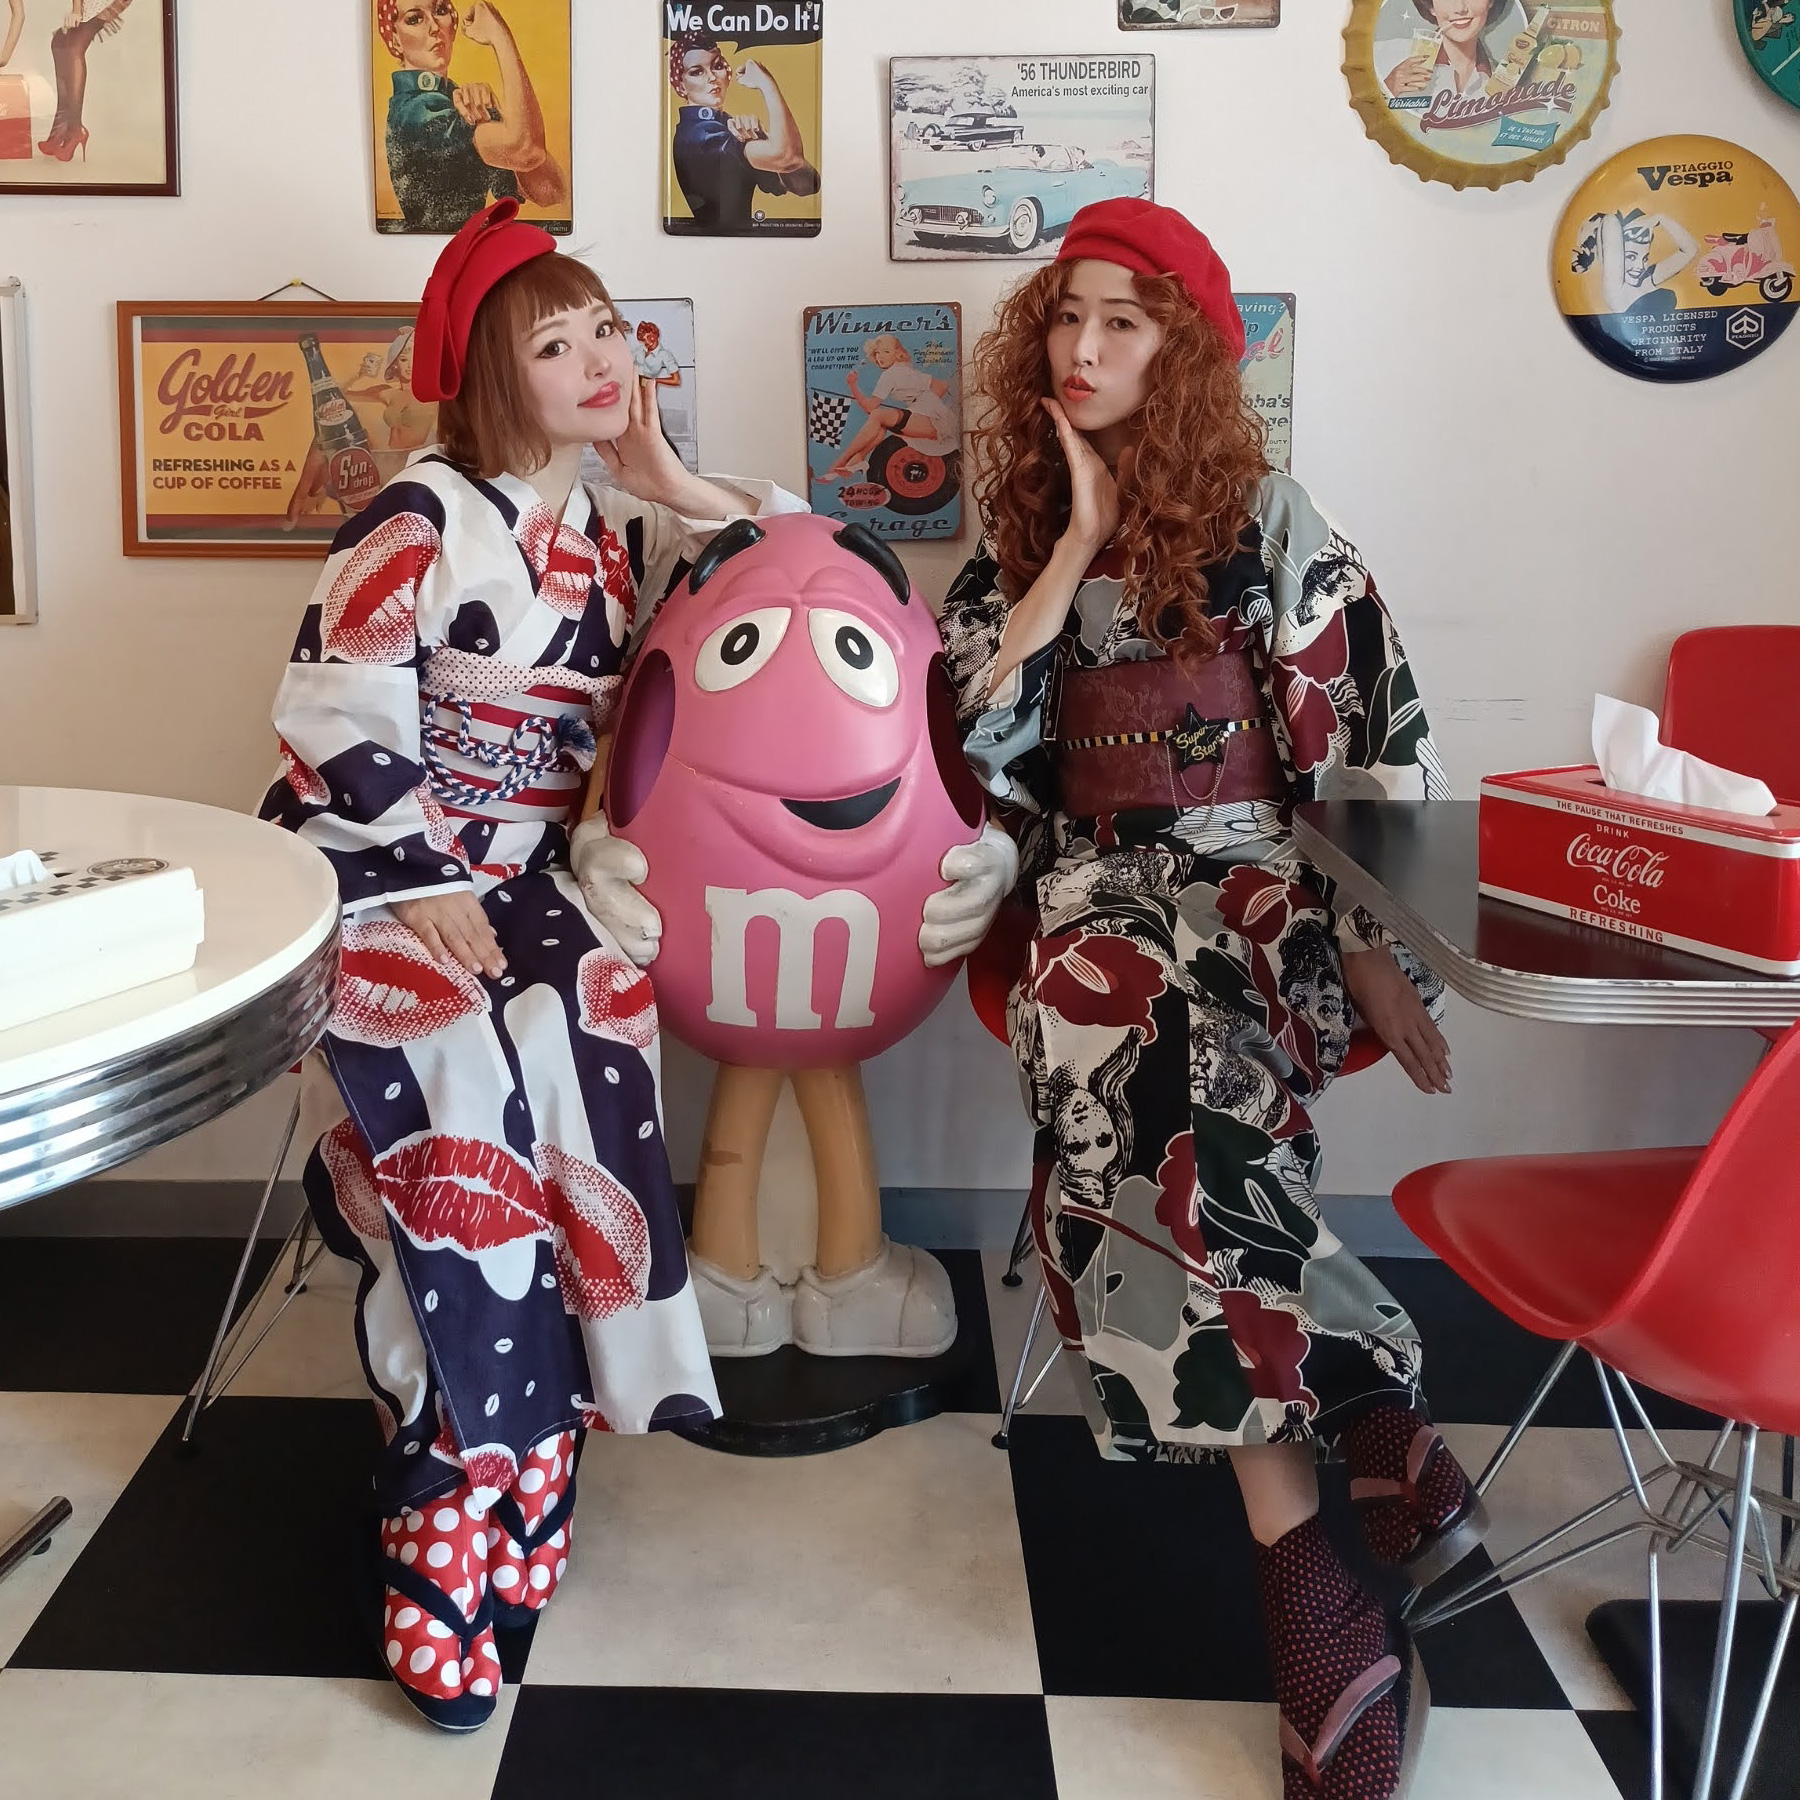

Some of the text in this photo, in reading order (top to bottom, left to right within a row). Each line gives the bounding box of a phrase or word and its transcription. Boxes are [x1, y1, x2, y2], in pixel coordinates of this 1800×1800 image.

[667, 3, 821, 32] We Can Do It!
[1547, 17, 1600, 33] CITRON
[1017, 60, 1141, 81] '56 THUNDERBIRD
[1011, 83, 1149, 97] America's most exciting car
[1421, 70, 1577, 123] Limonade
[1673, 161, 1733, 172] PIAGGIO
[1637, 165, 1734, 191] Vespa
[815, 309, 954, 335] Winner's
[1620, 310, 1718, 324] VESPA LICENSED
[1641, 323, 1697, 335] PRODUCTS
[1631, 333, 1707, 346] ORIGINARITY
[1634, 345, 1704, 357] FROM ITALY
[213, 404, 242, 420] Girl
[183, 421, 265, 441] COLA
[152, 458, 297, 472] REFRESHING AS A
[152, 476, 282, 490] CUP OF COFFEE
[353, 475, 374, 489] drop
[838, 486, 855, 498] 24
[1176, 725, 1209, 749] Super
[1191, 740, 1219, 761] Star
[1556, 800, 1684, 835] THE PAUSE THAT REFRESHES
[1596, 823, 1629, 839] DRINK
[1566, 833, 1670, 889] Coca-Cola
[1593, 884, 1641, 914] Coke
[1569, 907, 1664, 943] REFRESHING
[705, 885, 880, 1030] m
